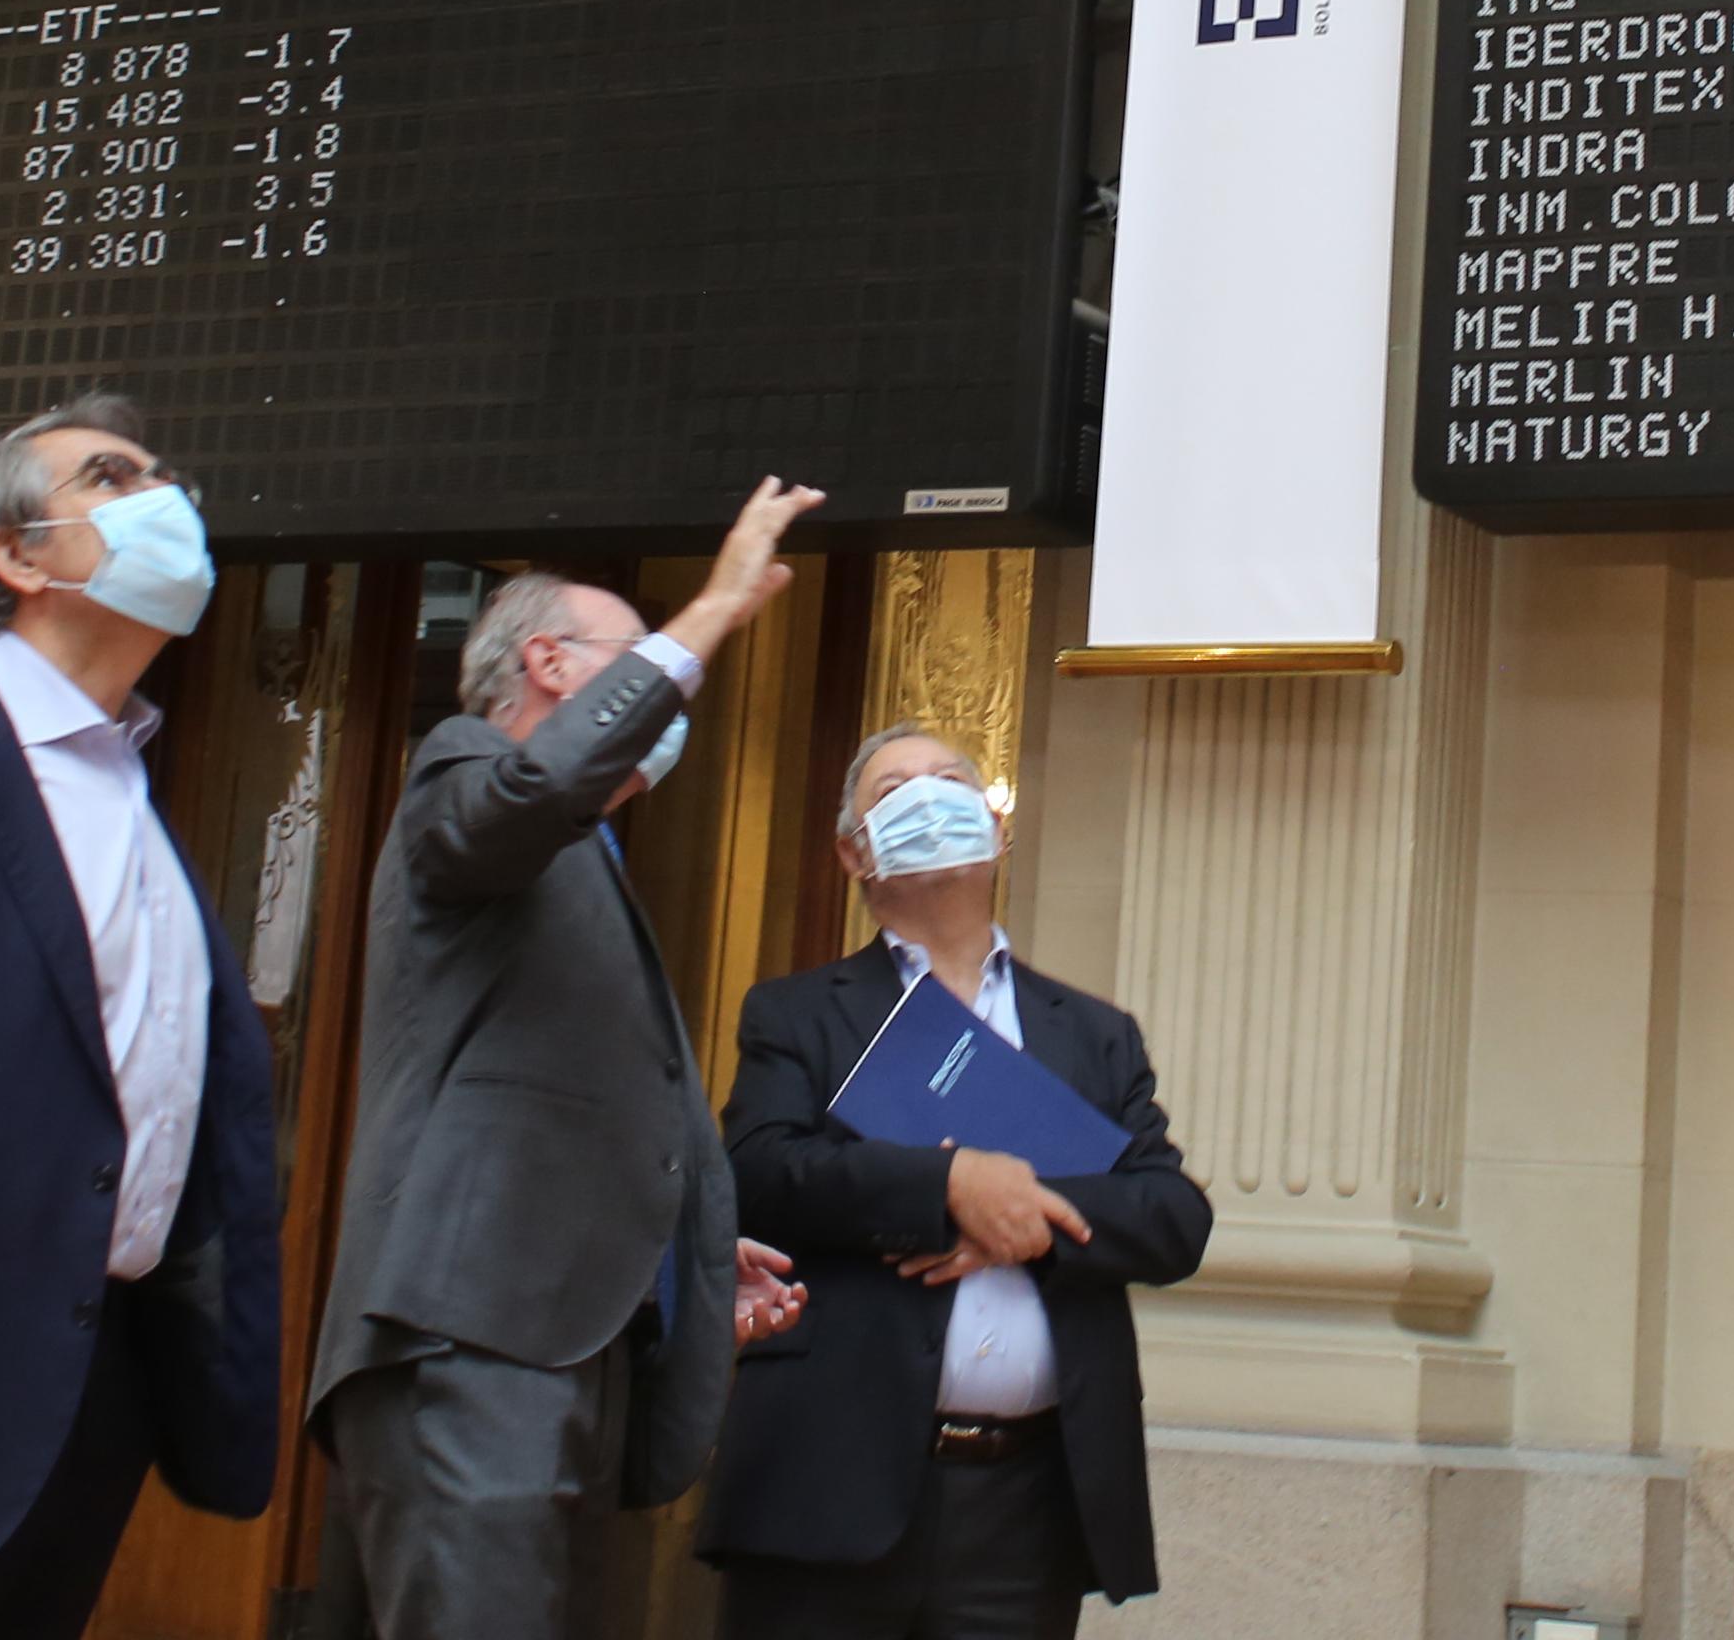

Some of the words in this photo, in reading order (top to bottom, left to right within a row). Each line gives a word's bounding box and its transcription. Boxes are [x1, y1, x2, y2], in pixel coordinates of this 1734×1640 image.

[31, 88, 184, 135] 15.482
[238, 74, 344, 117] -3.4
[1470, 65, 1725, 127] INDITEX
[10, 229, 166, 275] 39.360
[221, 218, 328, 260] -1.6
